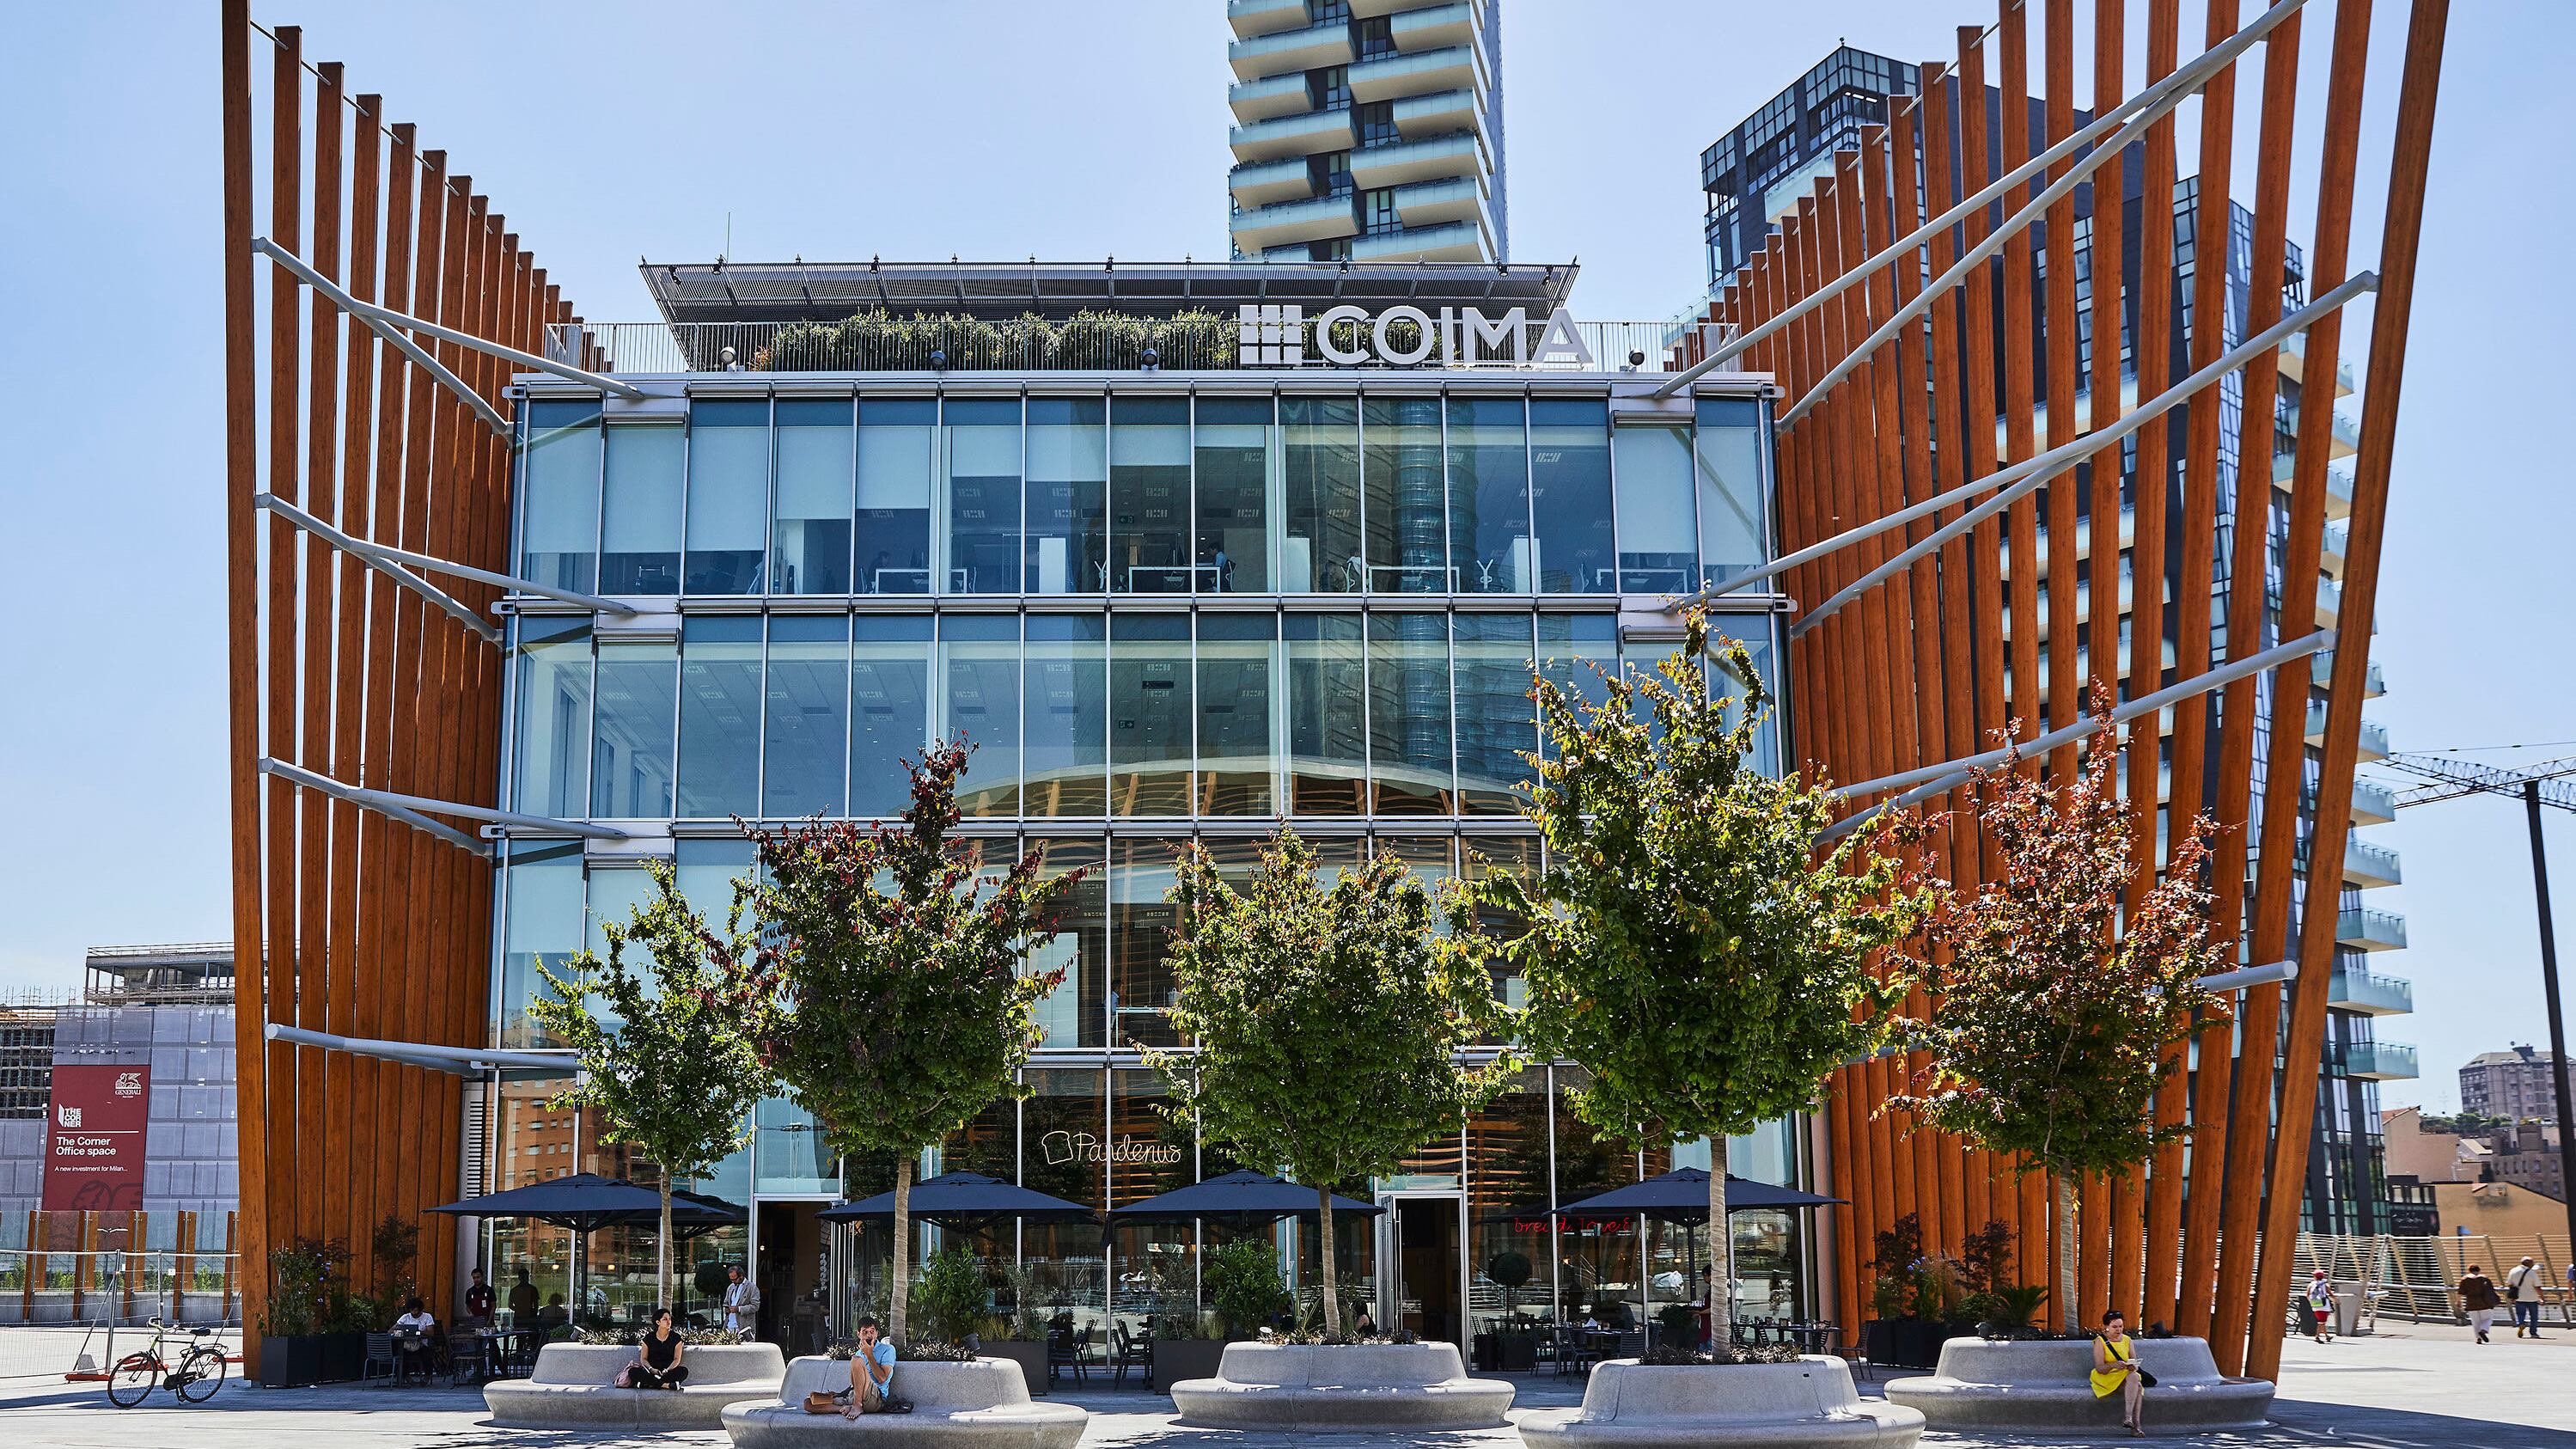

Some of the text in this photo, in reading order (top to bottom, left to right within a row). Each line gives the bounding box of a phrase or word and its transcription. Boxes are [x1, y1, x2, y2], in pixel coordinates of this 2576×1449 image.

[1316, 305, 1595, 365] COIMA
[56, 1136, 111, 1146] The Corner
[56, 1146, 116, 1157] Office space
